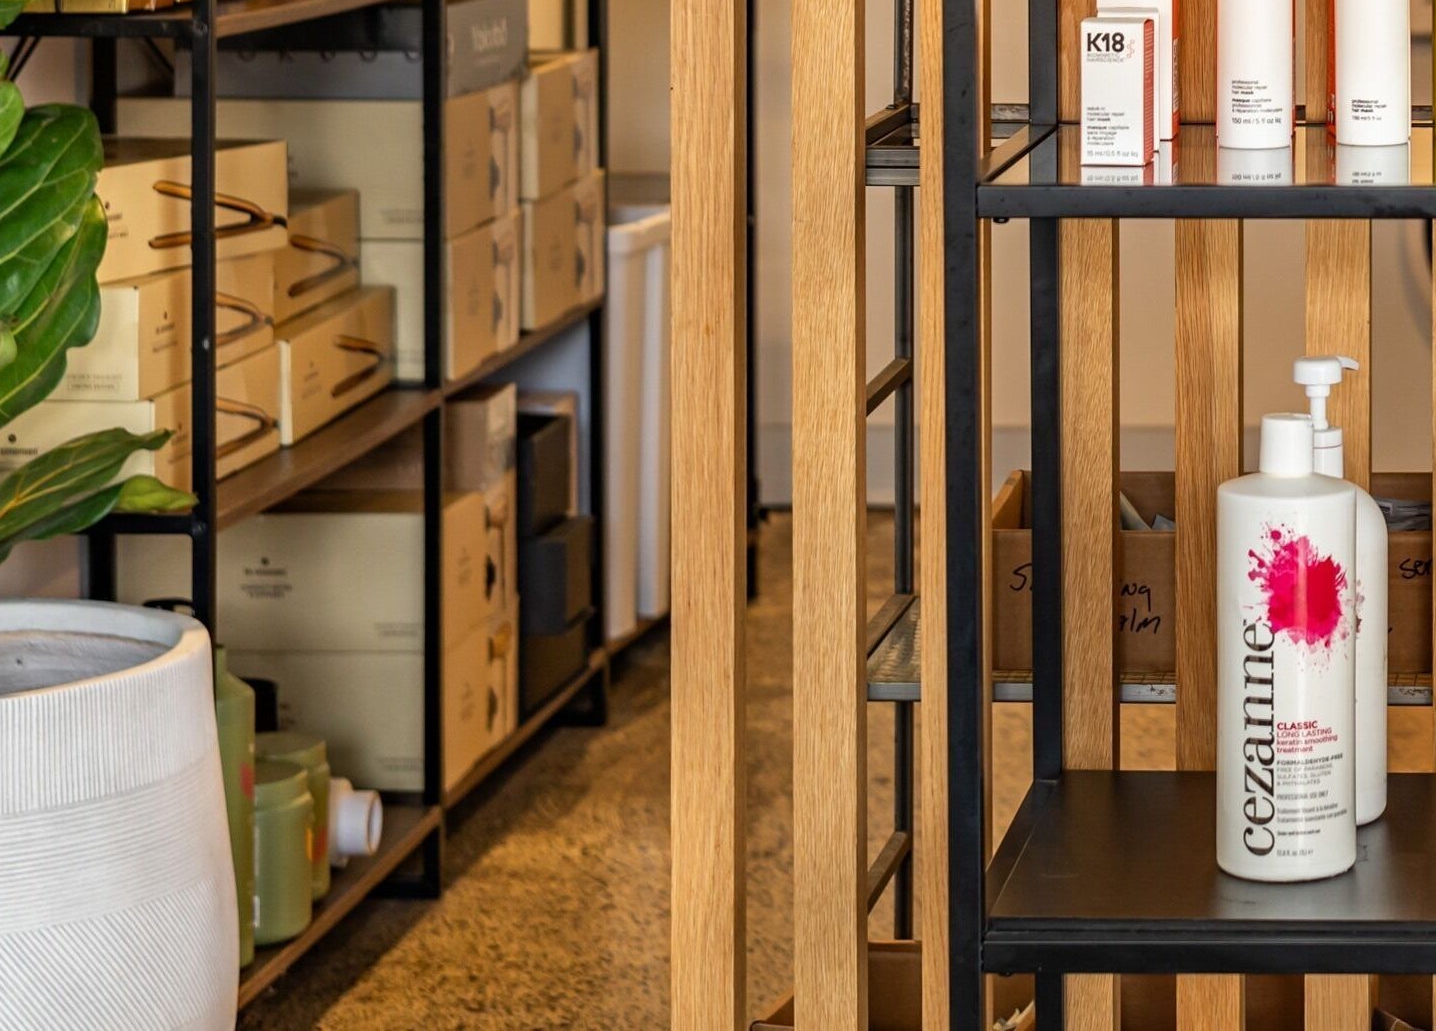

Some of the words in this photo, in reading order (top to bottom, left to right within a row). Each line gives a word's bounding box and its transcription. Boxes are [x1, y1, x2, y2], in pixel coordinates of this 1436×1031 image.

[1087, 32, 1125, 53] K18
[1276, 720, 1318, 731] CLASSIC
[1242, 621, 1275, 857] cezanne
[1276, 729, 1301, 739] LONG
[1301, 727, 1333, 738] LASTING
[1303, 734, 1338, 746] smoothing
[1276, 744, 1314, 753] treatment
